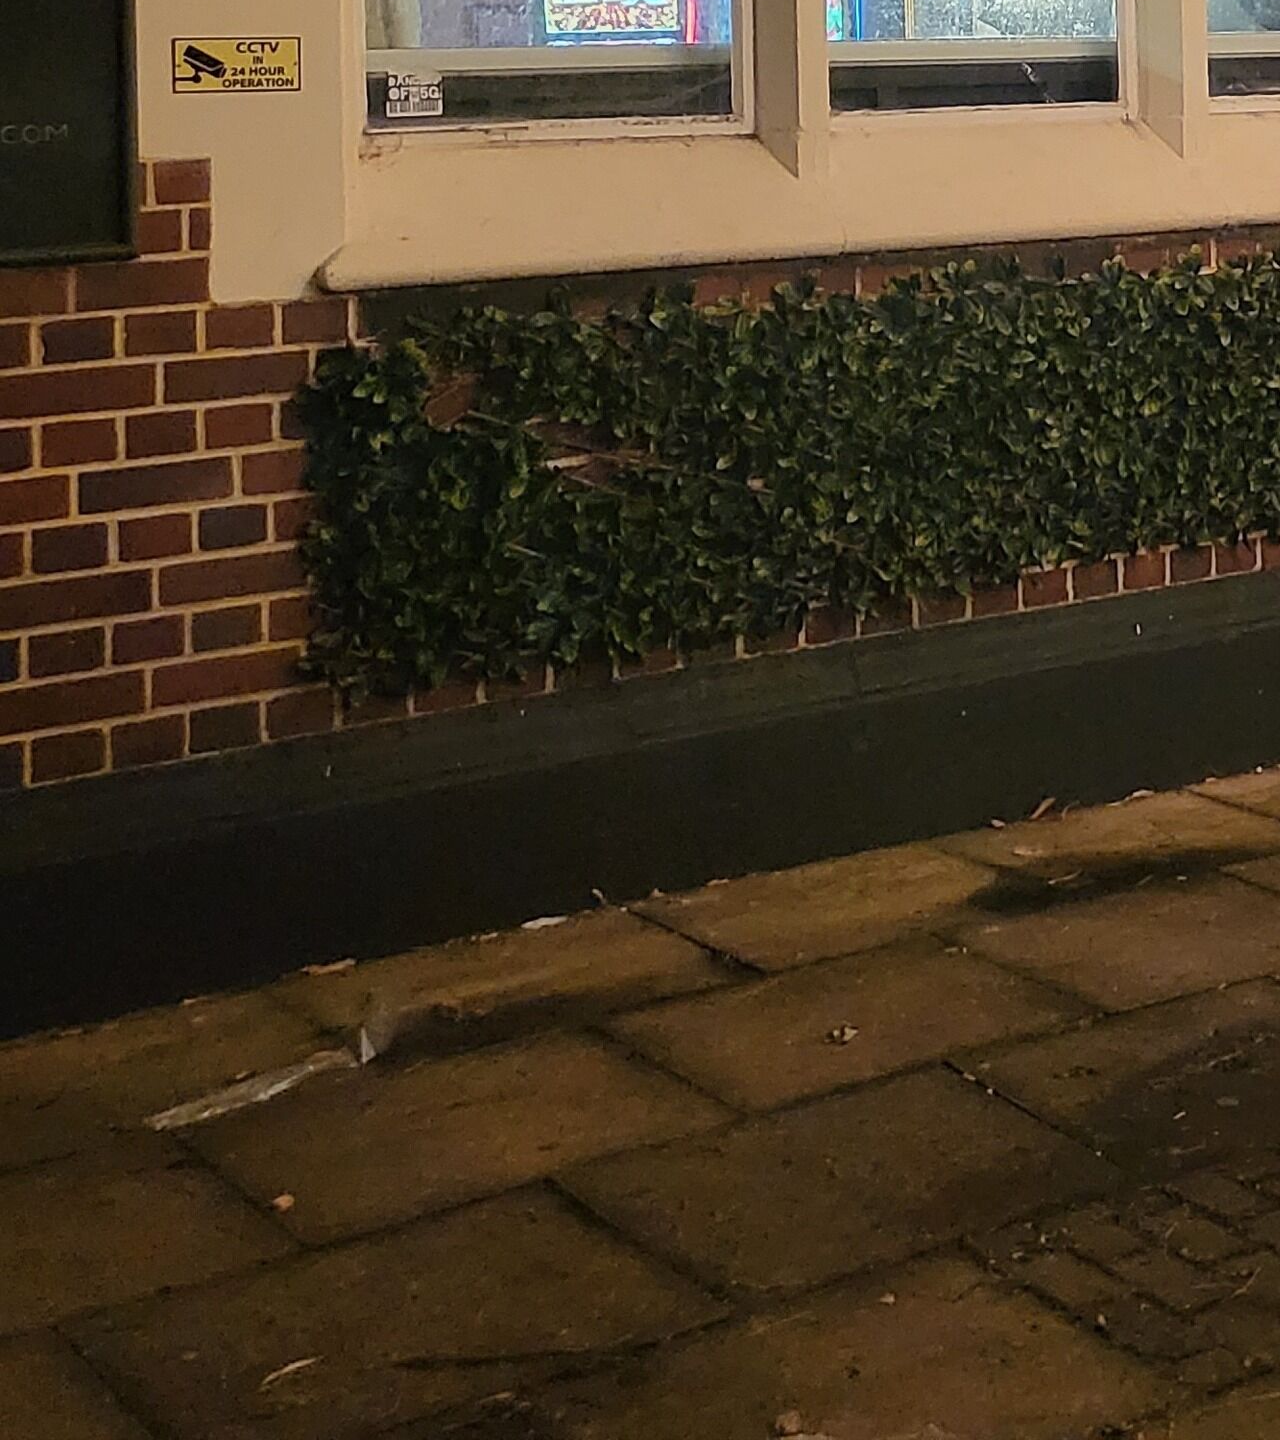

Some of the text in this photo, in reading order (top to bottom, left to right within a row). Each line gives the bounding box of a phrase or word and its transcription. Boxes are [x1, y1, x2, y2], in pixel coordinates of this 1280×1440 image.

[235, 41, 280, 54] CCTV
[252, 55, 264, 65] IN
[230, 66, 285, 77] 24 HOUR
[222, 77, 294, 88] OPERATION
